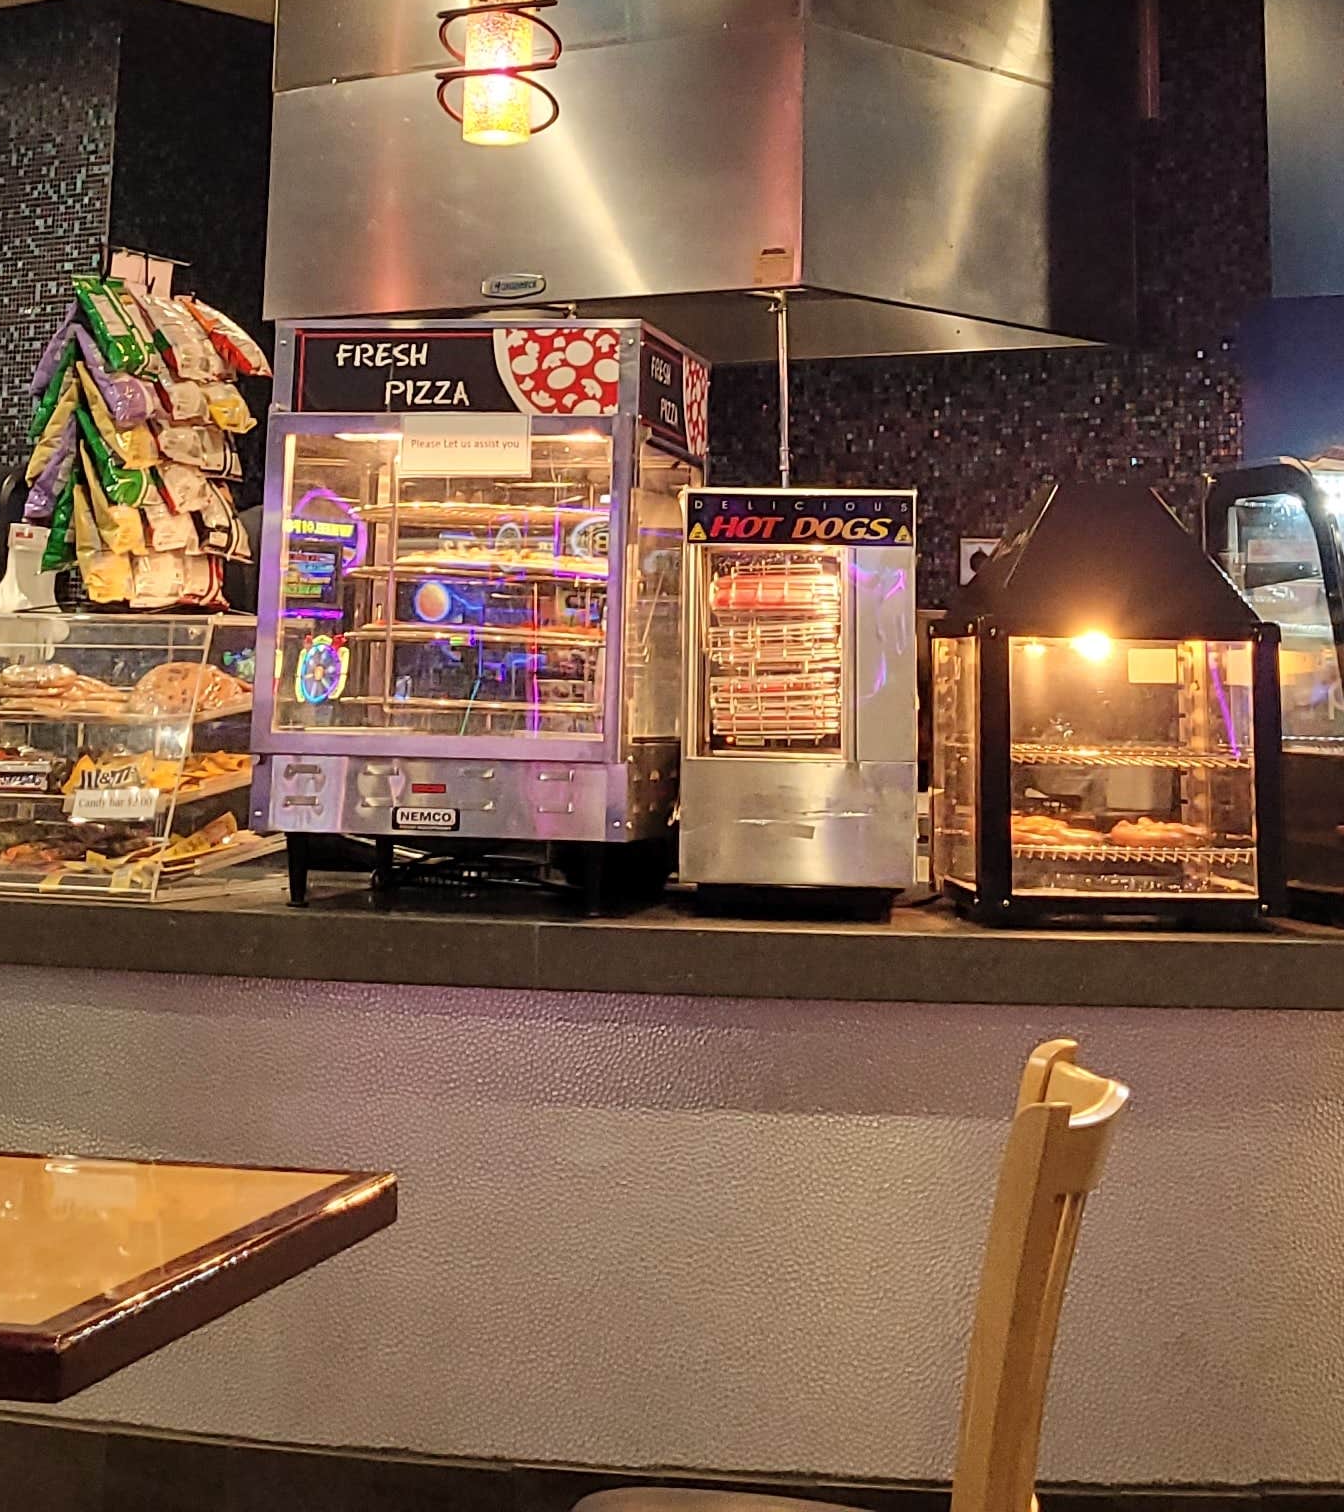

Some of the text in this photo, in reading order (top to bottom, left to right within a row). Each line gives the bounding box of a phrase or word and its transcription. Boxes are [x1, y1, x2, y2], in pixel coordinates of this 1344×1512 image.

[336, 343, 429, 367] FRESH
[650, 355, 672, 386] FRESH
[384, 381, 471, 407] PIZZA
[659, 397, 679, 426] PIZZA
[411, 438, 520, 450] Please Let us assist you
[694, 499, 909, 512] DELICIOUS
[710, 515, 894, 540] HOT DOGS
[78, 796, 106, 809] Candy
[400, 811, 452, 823] NEMCO
